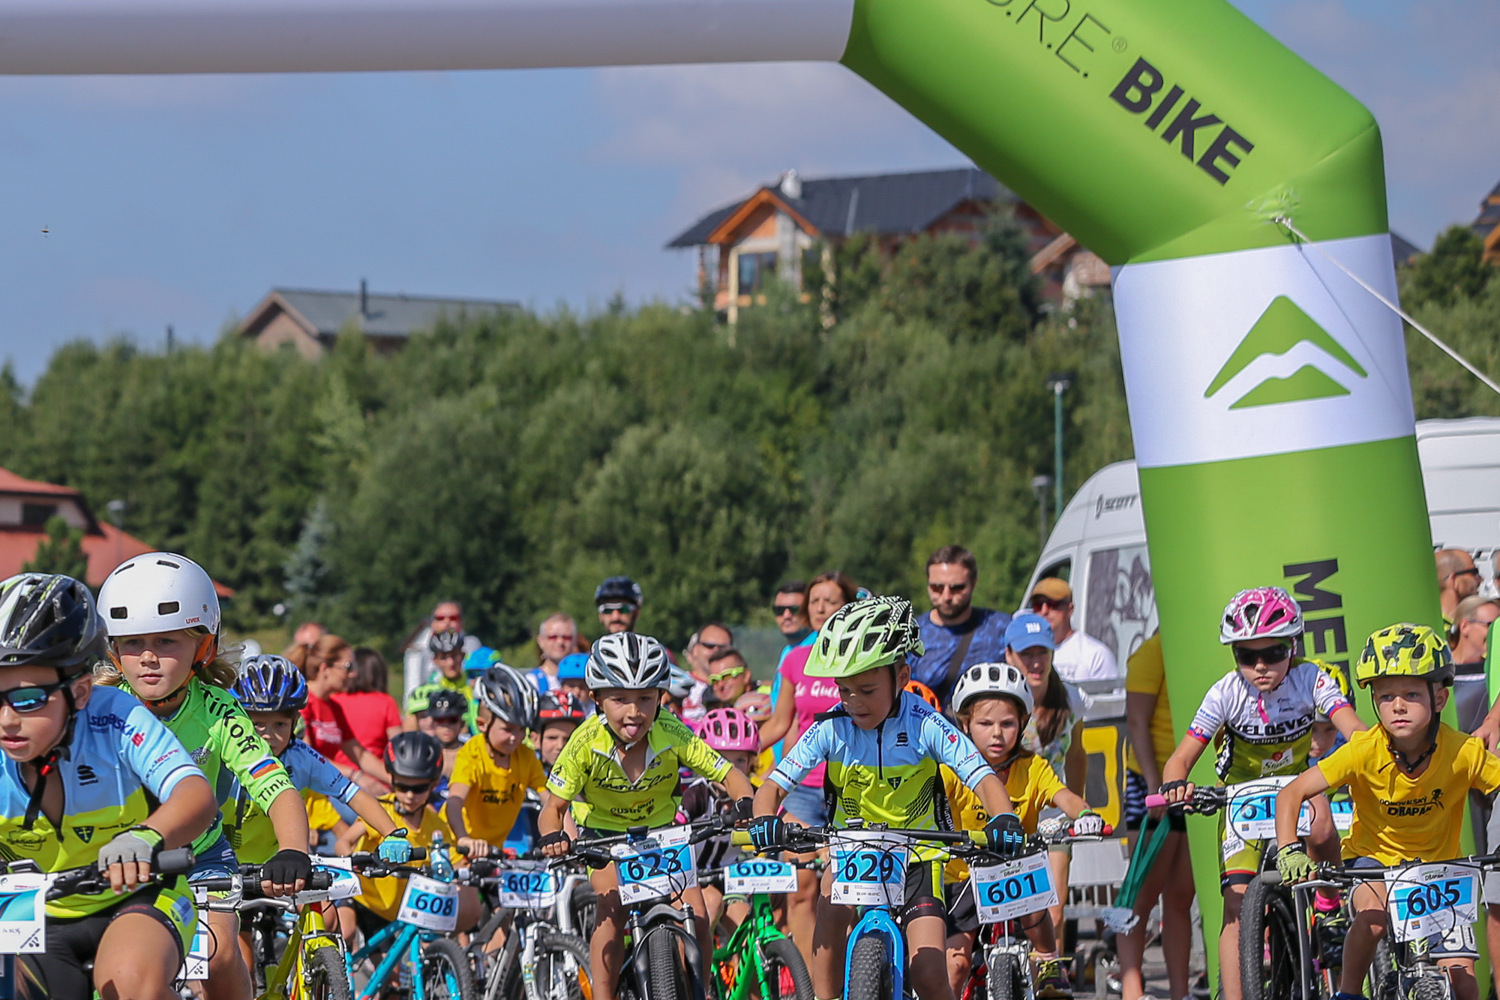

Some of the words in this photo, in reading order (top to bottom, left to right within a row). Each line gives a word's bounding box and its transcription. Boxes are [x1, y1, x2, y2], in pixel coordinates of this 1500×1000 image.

[1108, 56, 1255, 187] BIKE
[1240, 796, 1273, 820] 61
[736, 862, 783, 876] 609
[844, 853, 894, 882] 629
[507, 874, 544, 893] 602
[987, 873, 1037, 904] 601
[415, 893, 454, 917] 608
[1407, 880, 1460, 916] 605
